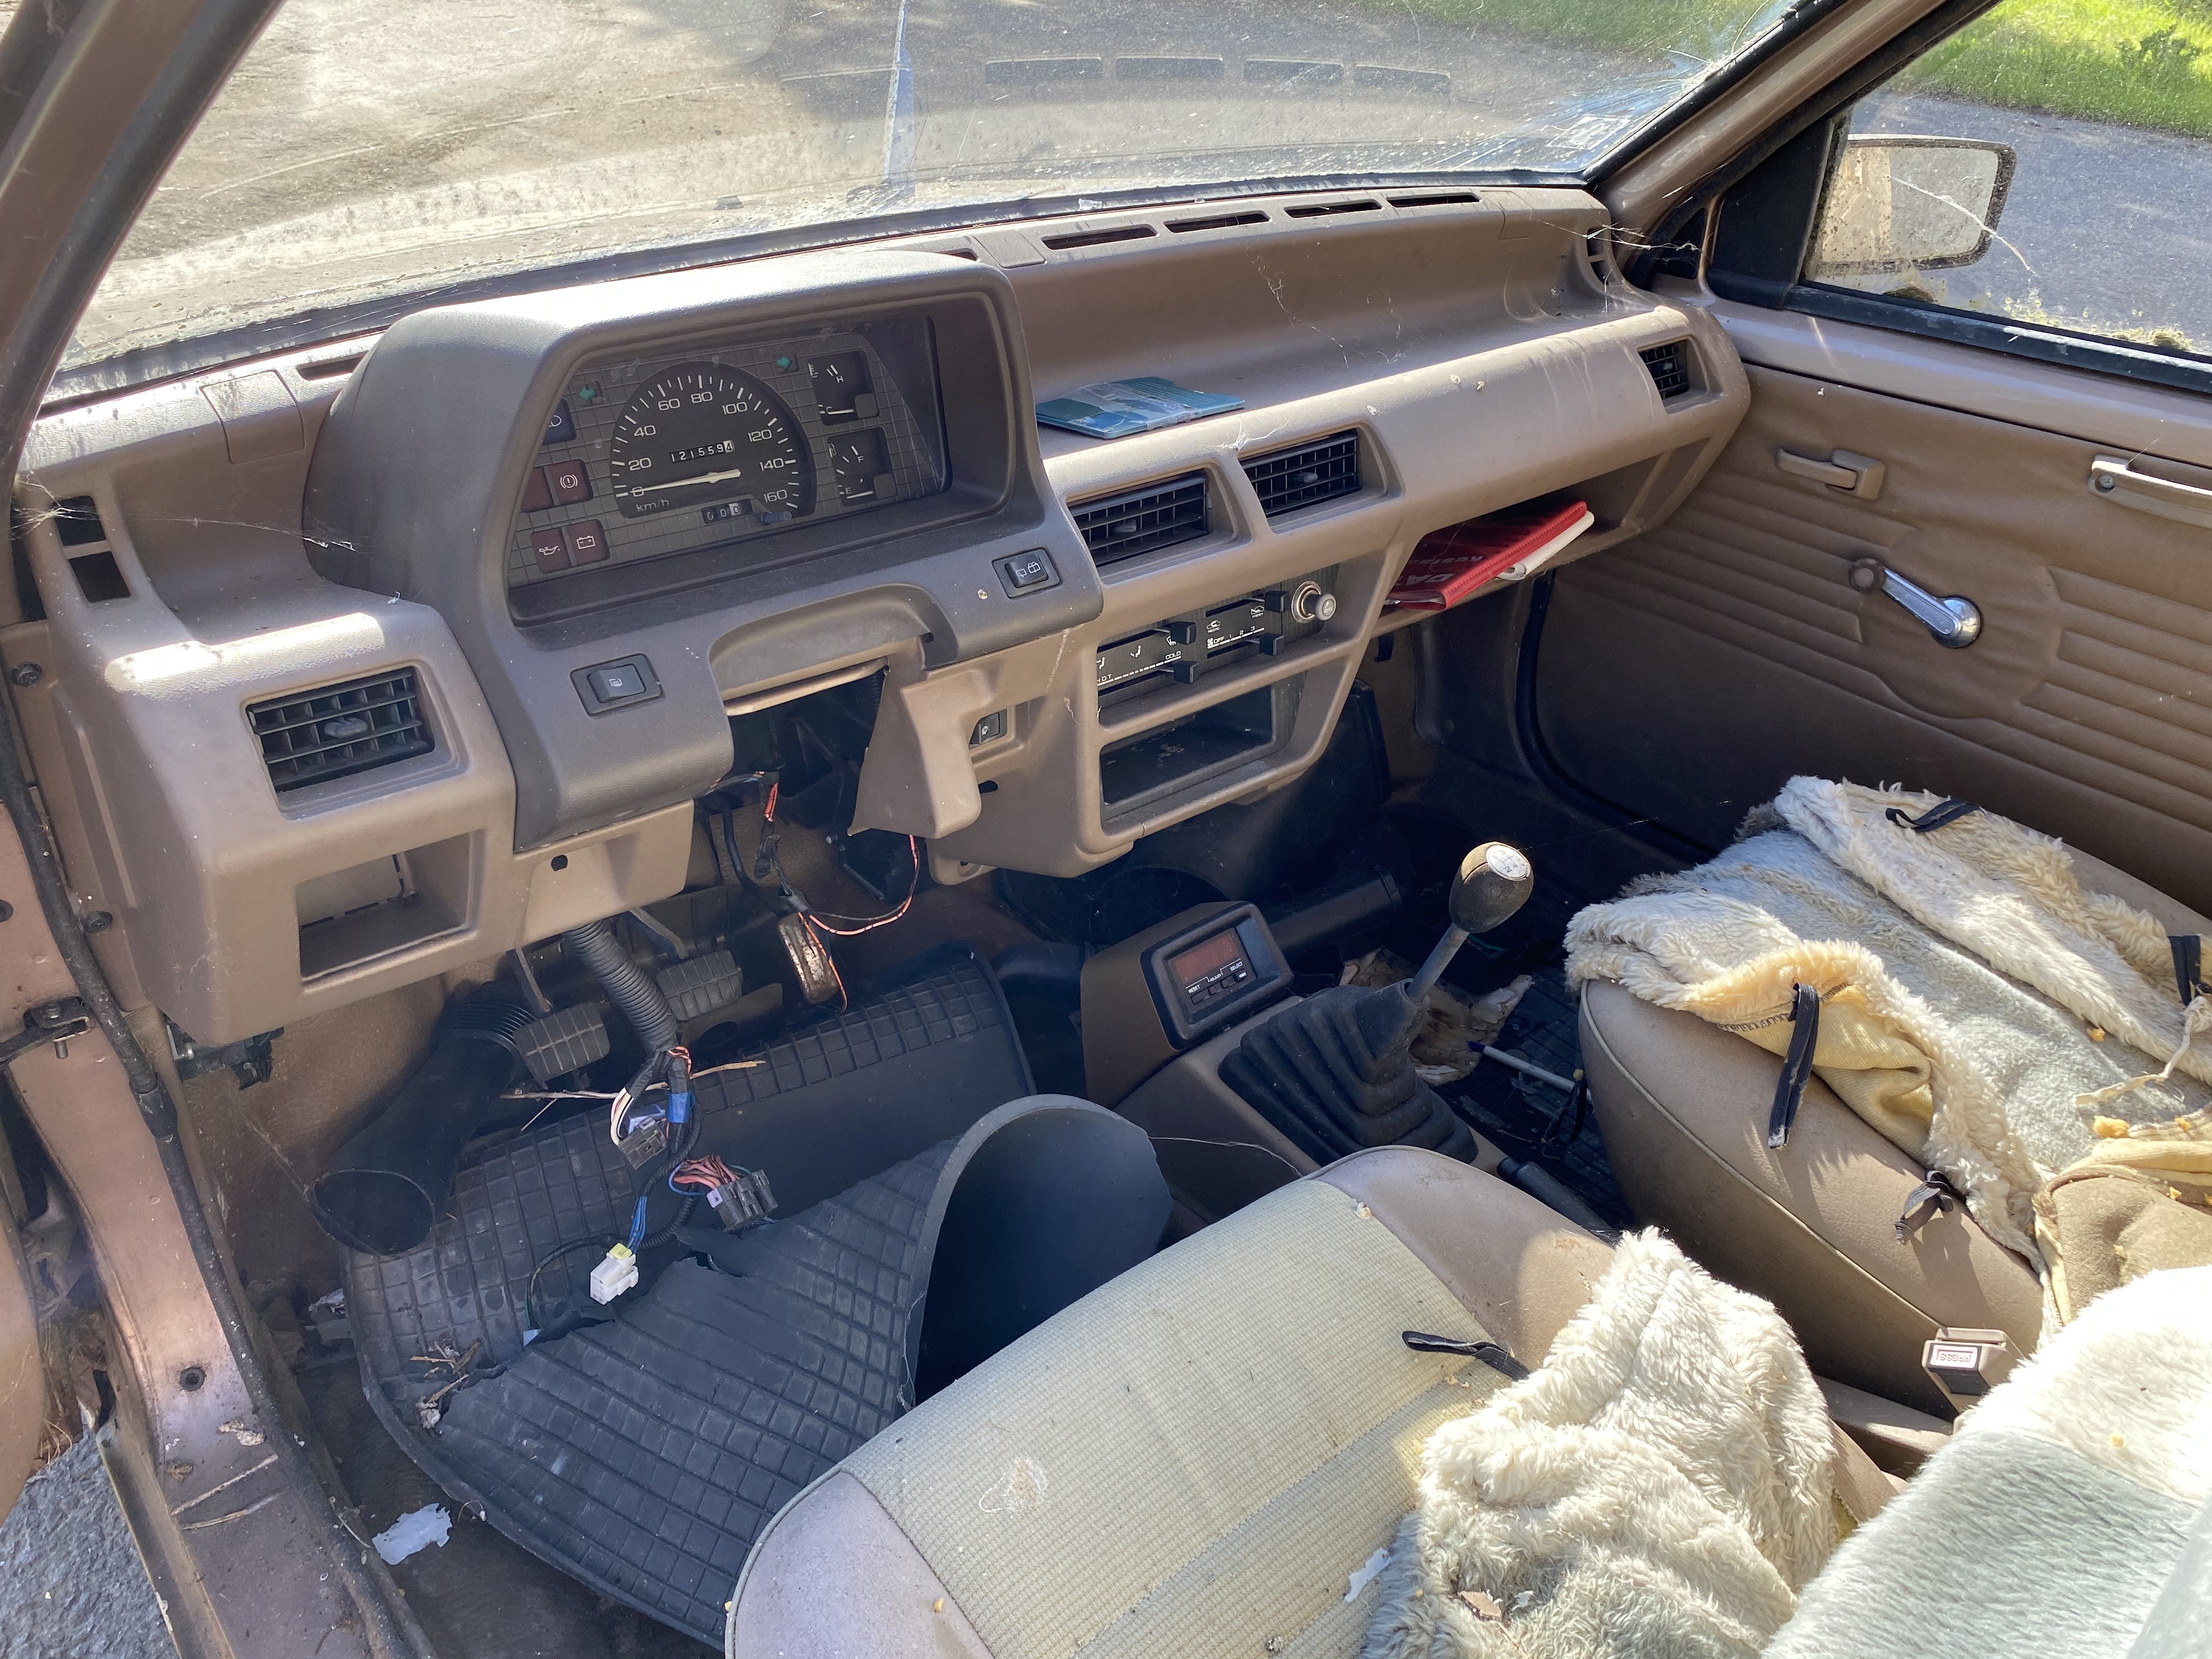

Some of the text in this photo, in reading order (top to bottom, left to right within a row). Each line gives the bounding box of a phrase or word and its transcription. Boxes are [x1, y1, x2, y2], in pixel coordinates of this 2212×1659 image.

[691, 391, 713, 404] 80
[658, 398, 681, 411] 60
[722, 402, 748, 415] 100
[634, 425, 656, 437] 40
[748, 429, 772, 442] 120
[628, 458, 652, 471] 20
[759, 458, 785, 471] 140
[764, 489, 788, 503] 160
[636, 499, 670, 512] km/h
[1214, 636, 1225, 644] OFF
[1165, 651, 1181, 659] COLD
[1229, 961, 1243, 972] SELECT
[1210, 973, 1222, 982] ADJUST
[1188, 984, 1200, 994] RESET
[1939, 1352, 1972, 1362] PRESS
